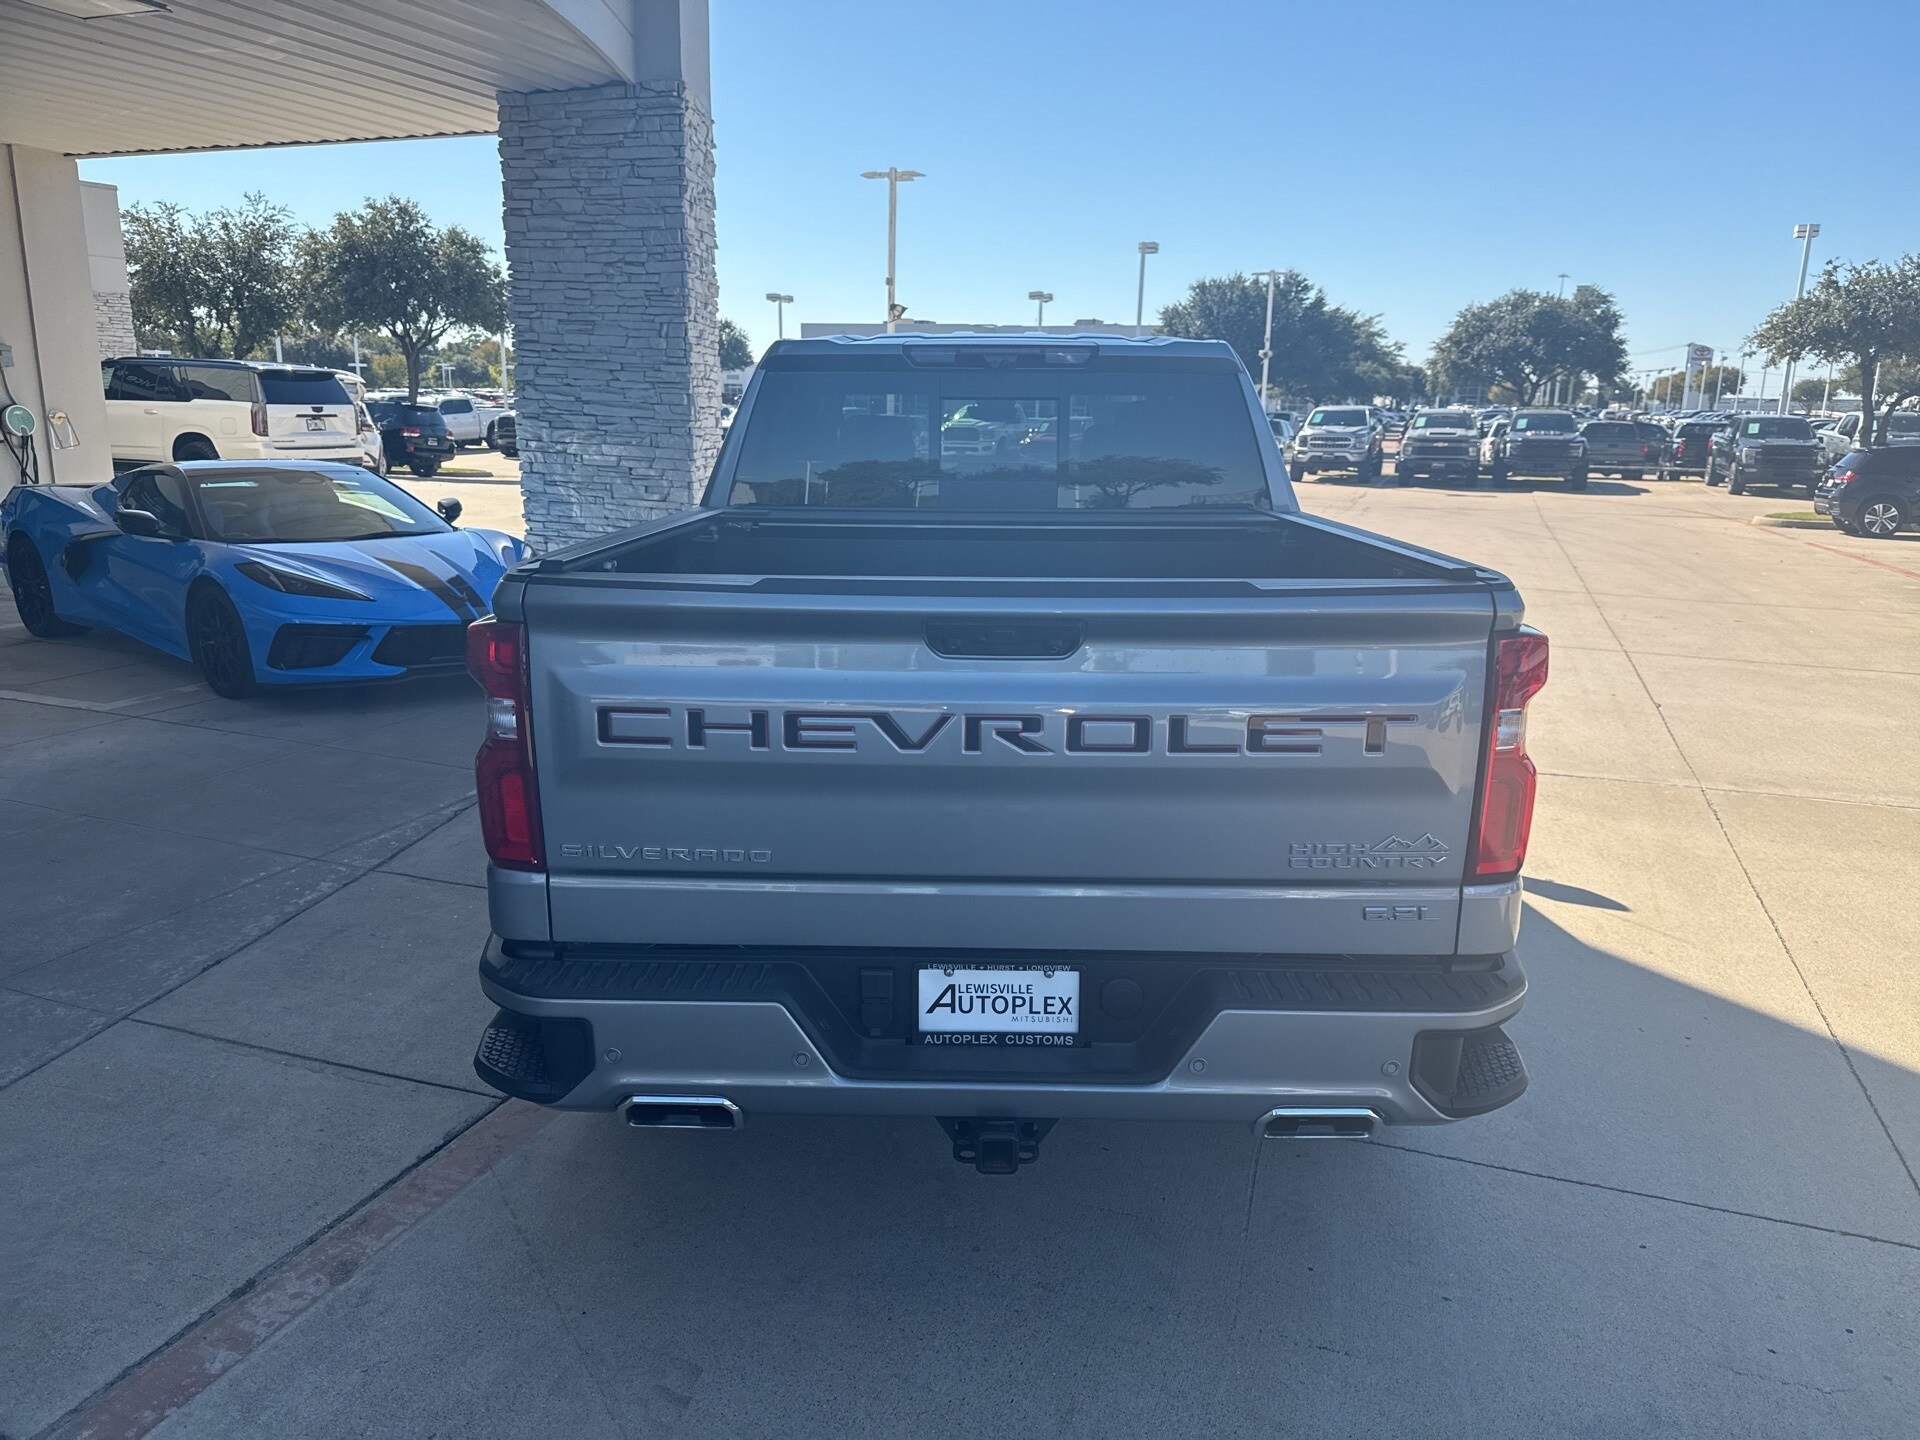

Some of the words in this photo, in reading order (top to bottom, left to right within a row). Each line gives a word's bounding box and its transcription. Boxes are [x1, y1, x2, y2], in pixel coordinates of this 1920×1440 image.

[596, 705, 1419, 756] CHEVROLET
[560, 844, 773, 863] SILVERADO
[1288, 842, 1370, 855] HIGH
[1288, 856, 1448, 868] COUNTRY
[1362, 905, 1440, 921] 6.2L
[927, 963, 977, 971] LEWISVILLE
[987, 964, 1016, 972] HURST
[957, 983, 1034, 995] LEWISVILLE
[925, 983, 1073, 1015] AUTOPLEX
[1011, 1015, 1074, 1024] MITSUBISHI
[924, 1034, 998, 1045] AUTOPLEX
[1005, 1034, 1074, 1046] CUSTOMS
